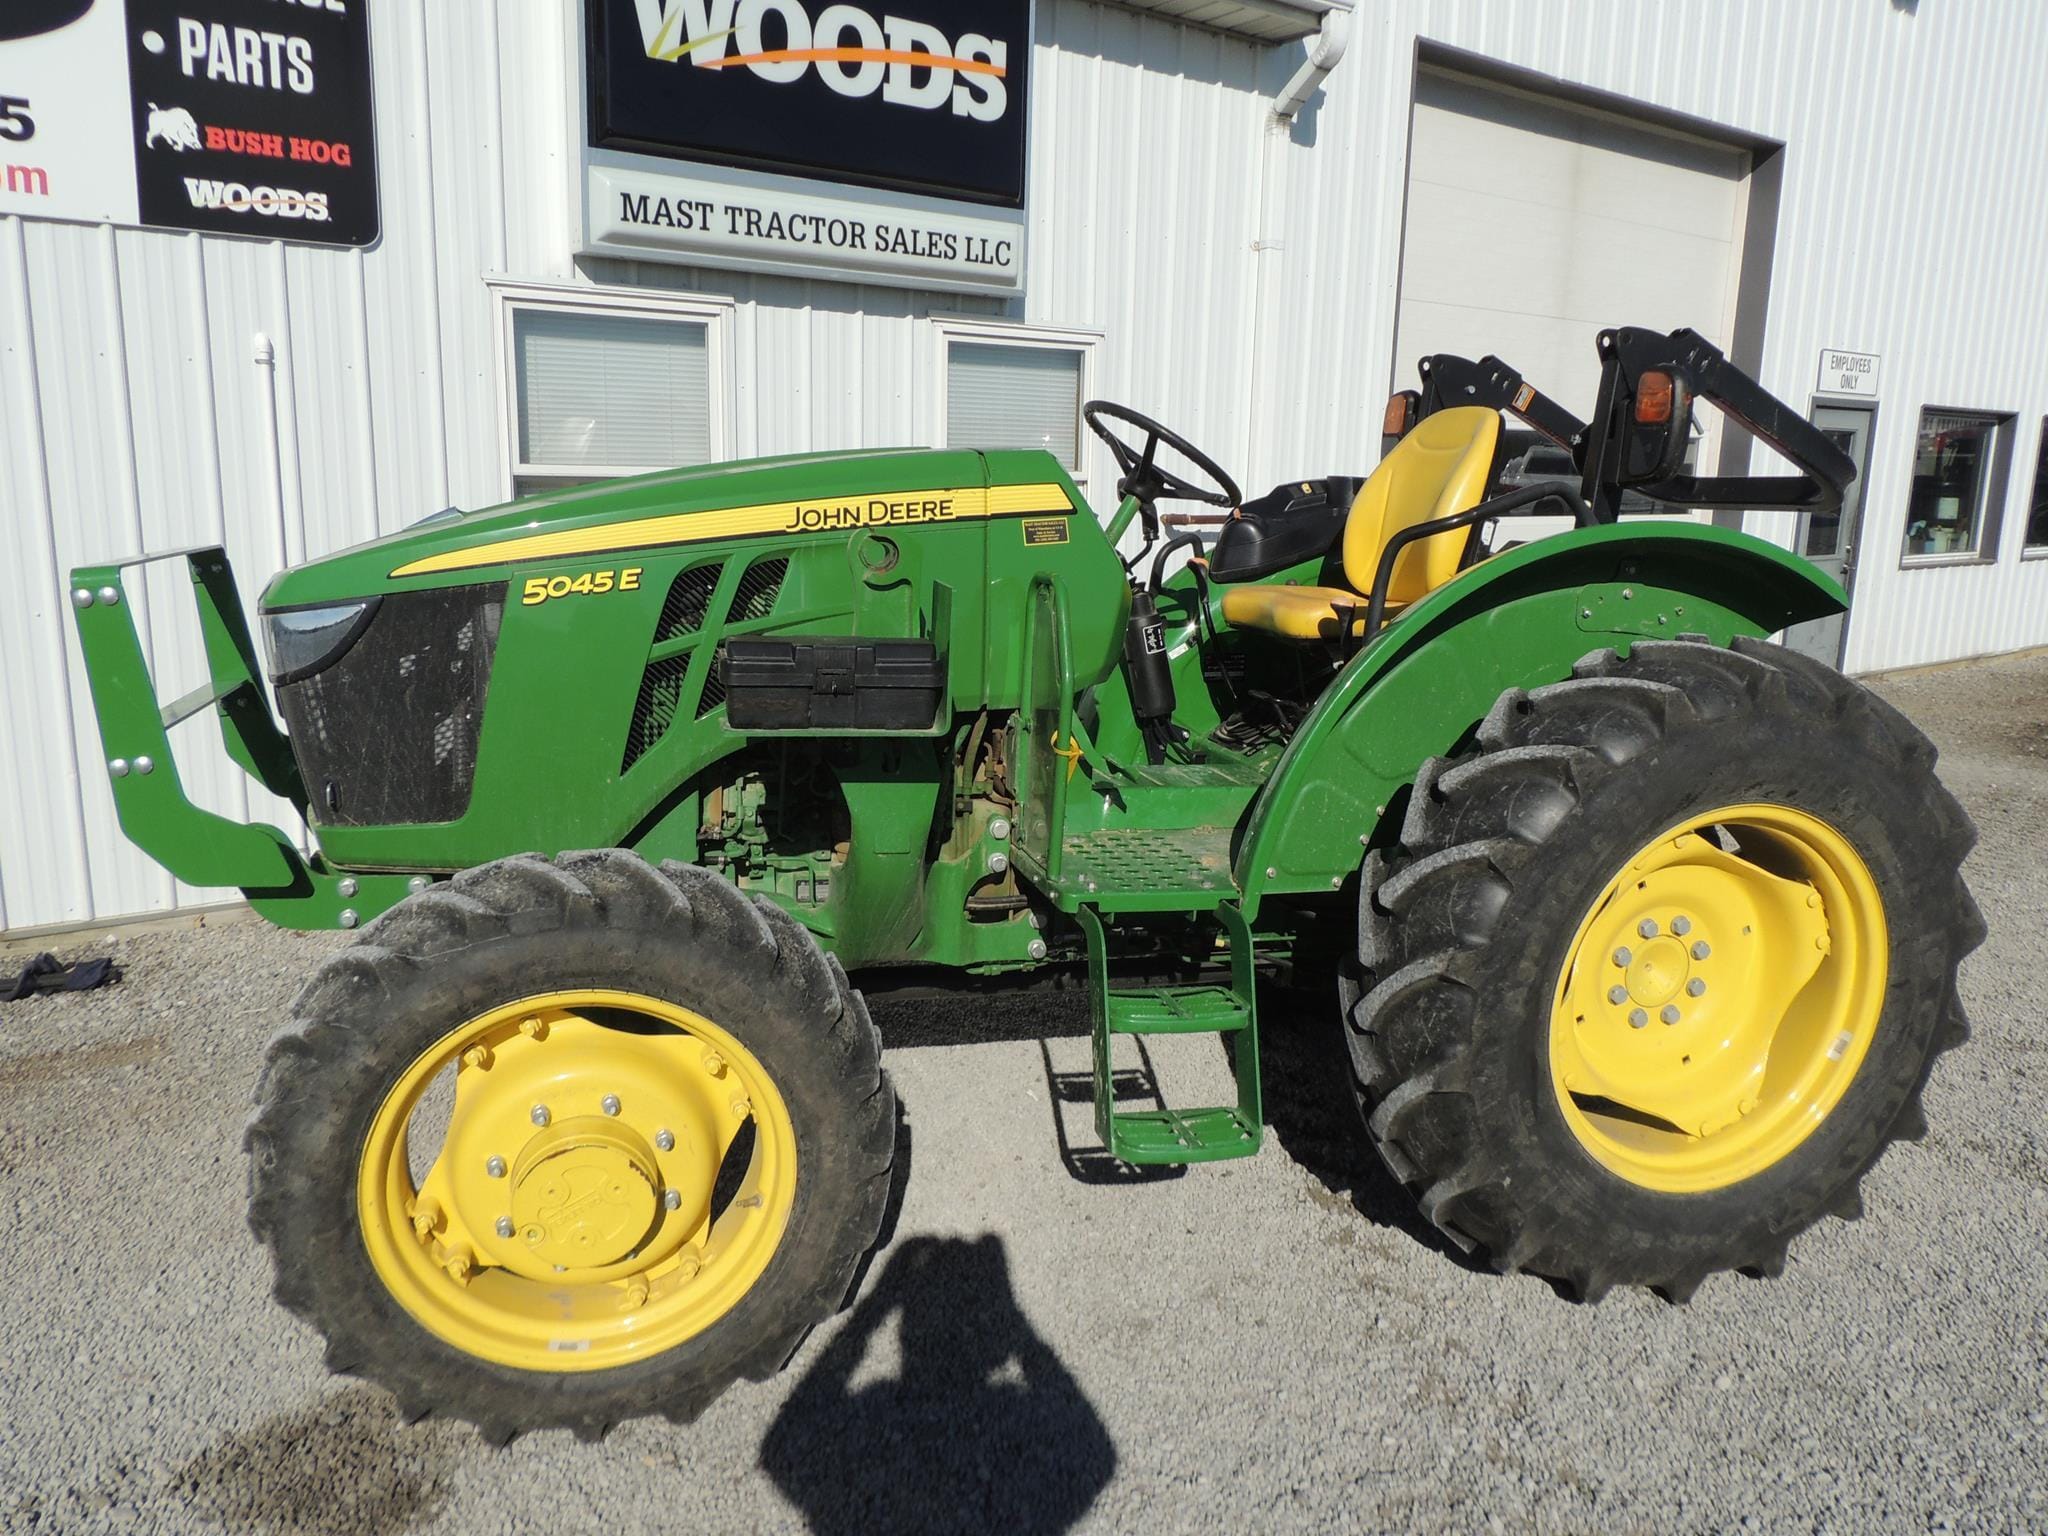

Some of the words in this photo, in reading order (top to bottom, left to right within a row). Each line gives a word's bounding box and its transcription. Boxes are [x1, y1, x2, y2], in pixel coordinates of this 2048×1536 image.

[178, 17, 315, 94] PARTS
[635, 0, 1008, 122] WOODS
[204, 125, 284, 158] BUSH
[288, 137, 351, 166] HOG
[0, 163, 49, 196] m
[183, 177, 330, 222] WOODS
[620, 192, 714, 232] MAST
[723, 206, 867, 250] TRACTOR
[874, 224, 957, 261] SALES
[964, 236, 1011, 267] LLC
[1830, 355, 1872, 374] EMPLOYEES
[1840, 373, 1859, 390] ONLY
[785, 506, 861, 529] JOHN
[868, 499, 954, 522] DEERE
[522, 569, 615, 606] 5045
[618, 567, 643, 591] E
